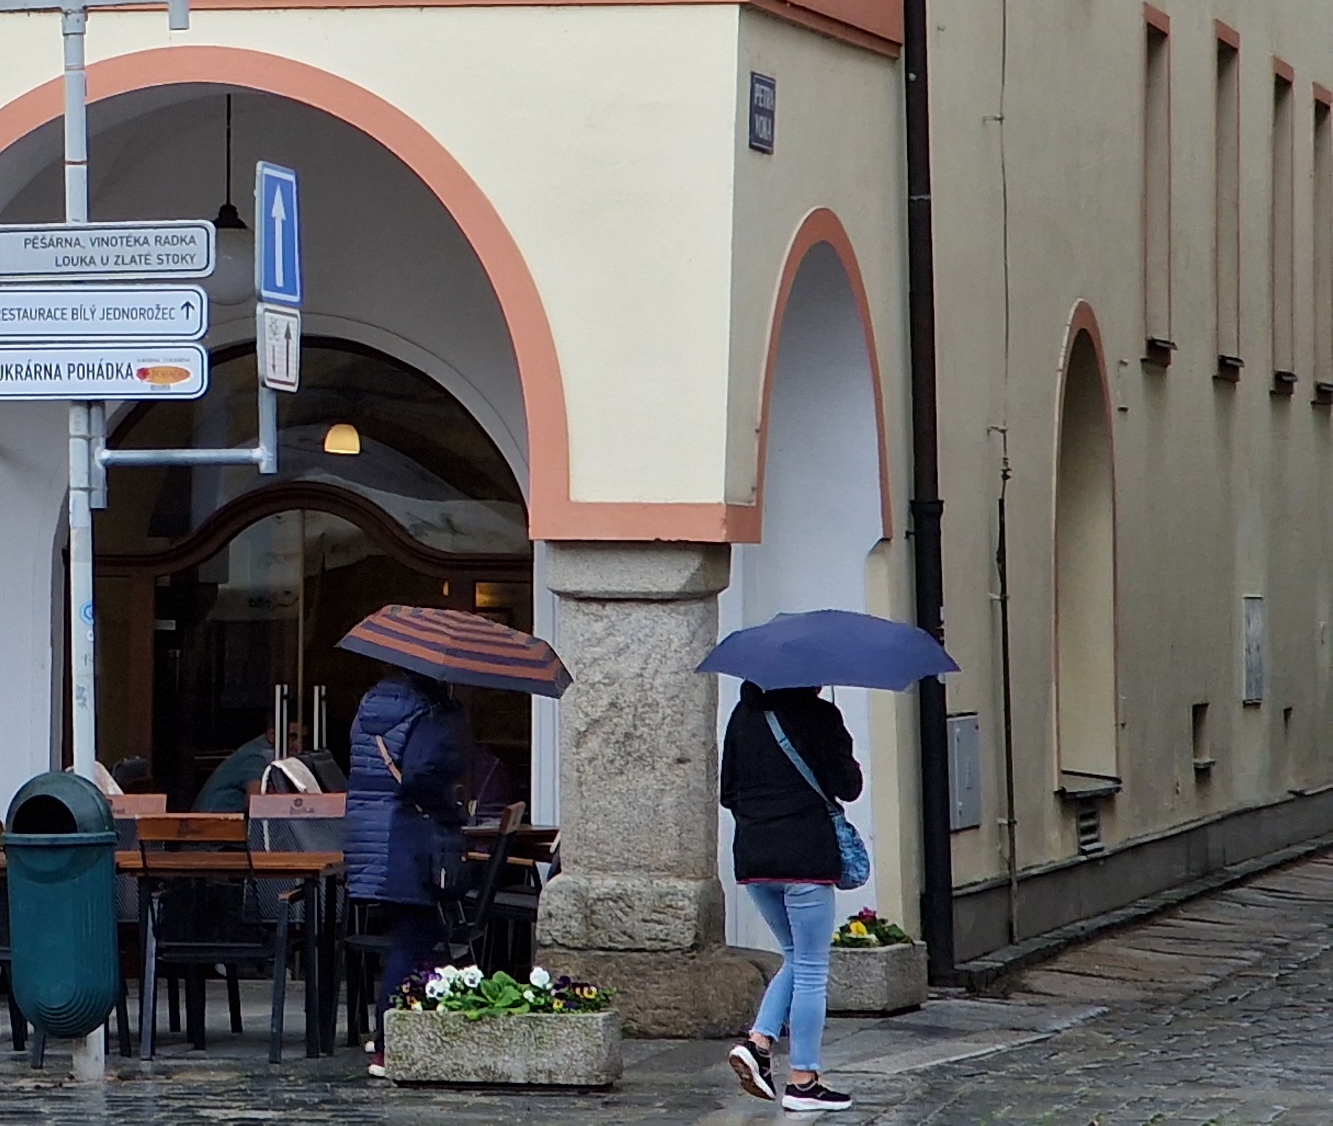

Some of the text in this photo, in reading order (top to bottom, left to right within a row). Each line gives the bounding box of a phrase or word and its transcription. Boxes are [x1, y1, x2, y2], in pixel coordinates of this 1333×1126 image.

[89, 234, 150, 248] VINOTÉKA
[154, 234, 197, 247] RADKA
[55, 252, 197, 267] LOUKA U ZLATÉ STOKY
[71, 304, 97, 321] BÍLÝ
[99, 304, 176, 321] JEDNOROŽEC
[67, 358, 134, 381] POHÁDKA
